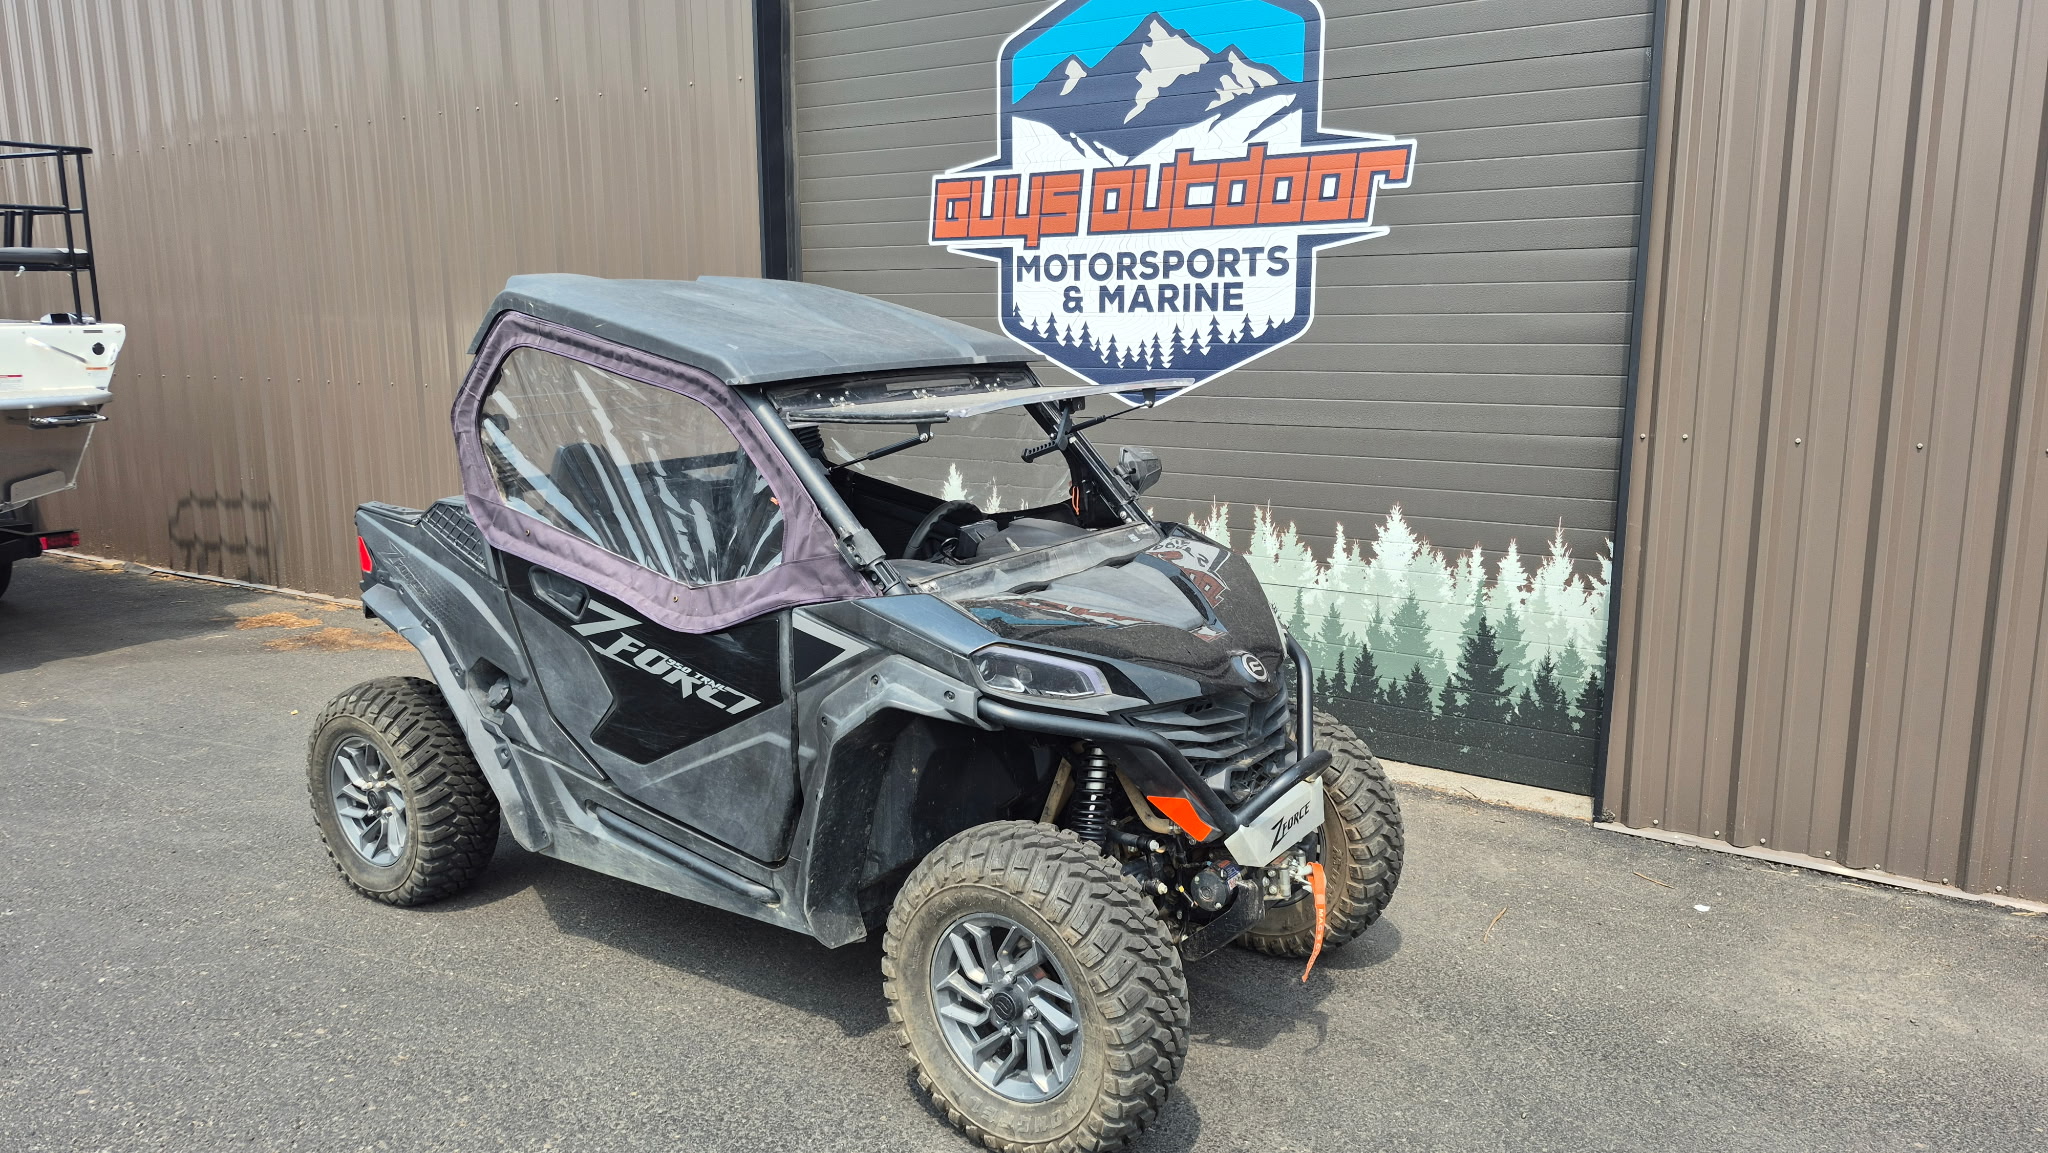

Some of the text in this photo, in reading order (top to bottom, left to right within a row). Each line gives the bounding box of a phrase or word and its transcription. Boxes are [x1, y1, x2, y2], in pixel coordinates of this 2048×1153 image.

[1016, 245, 1291, 284] MOTORSPORTS
[1062, 282, 1245, 314] & MARINE
[666, 658, 727, 692] 950 TRAIL
[1270, 800, 1311, 852] ZFORCE
